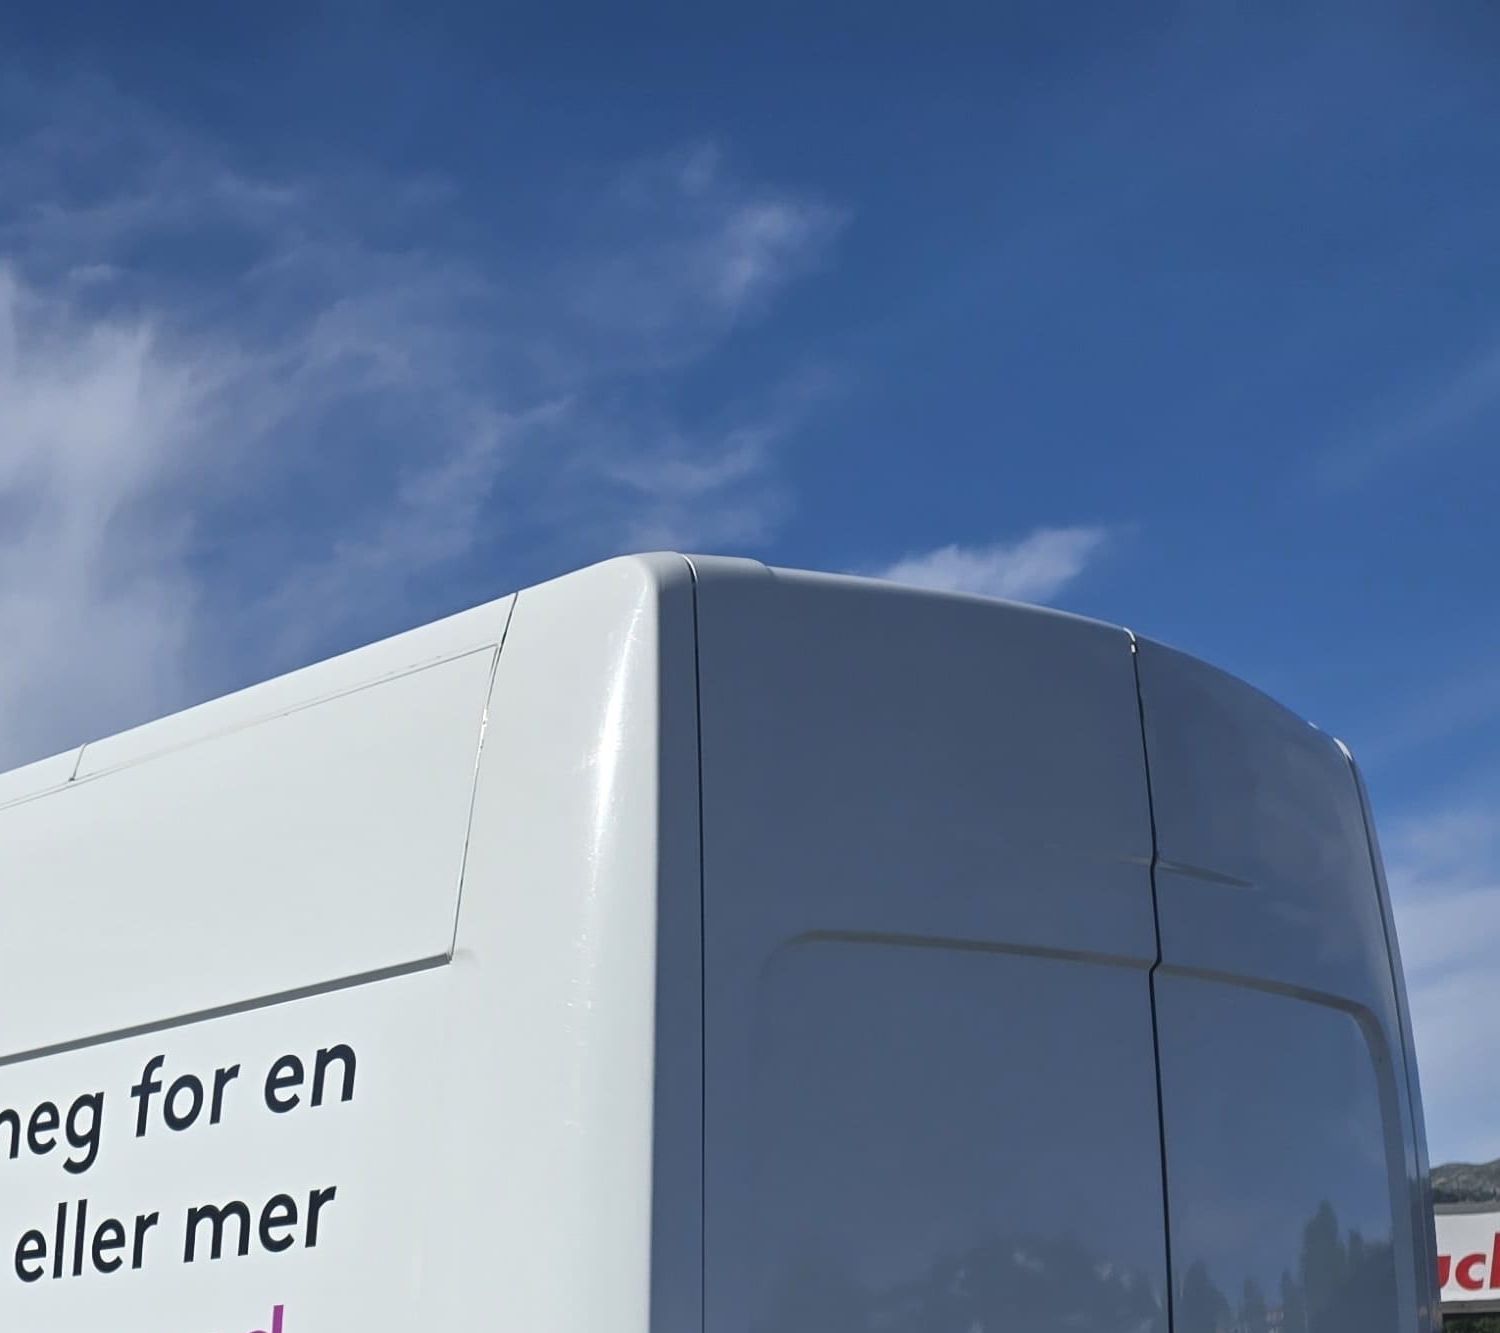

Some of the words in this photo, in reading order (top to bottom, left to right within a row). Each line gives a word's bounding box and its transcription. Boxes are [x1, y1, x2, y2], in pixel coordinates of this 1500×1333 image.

[130, 1054, 241, 1138] for
[264, 1043, 357, 1114] en
[14, 1198, 160, 1283] eller
[183, 1185, 337, 1264] mer
